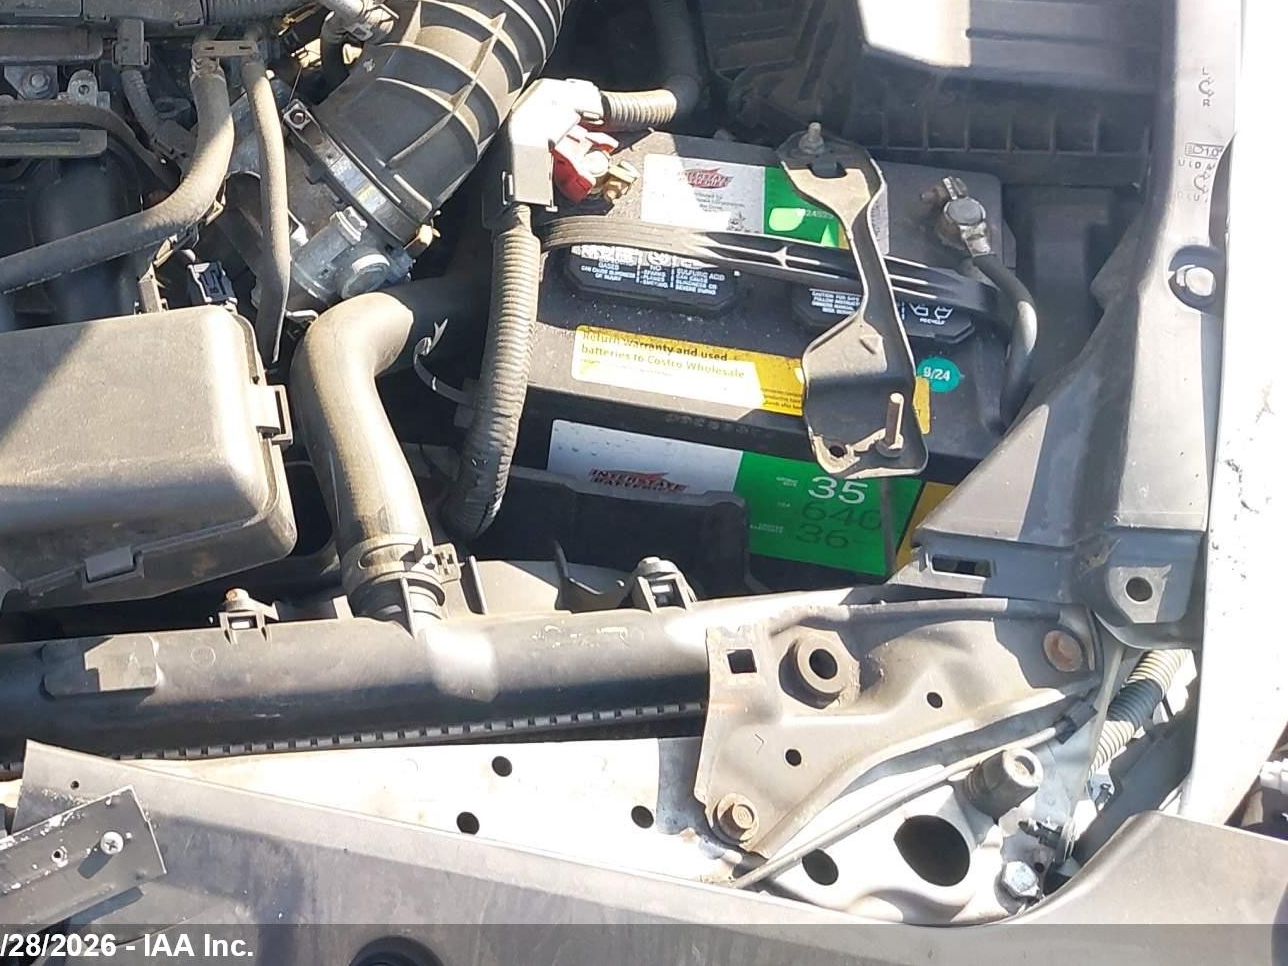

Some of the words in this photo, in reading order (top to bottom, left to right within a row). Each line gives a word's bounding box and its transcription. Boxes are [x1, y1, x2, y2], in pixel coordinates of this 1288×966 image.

[581, 343, 631, 361] batteries
[632, 350, 644, 363] to
[685, 358, 745, 379] Wholesale
[582, 330, 622, 346] Return
[623, 336, 675, 356] warranty
[676, 345, 699, 358] and
[701, 349, 729, 362] used
[808, 476, 868, 504] 35
